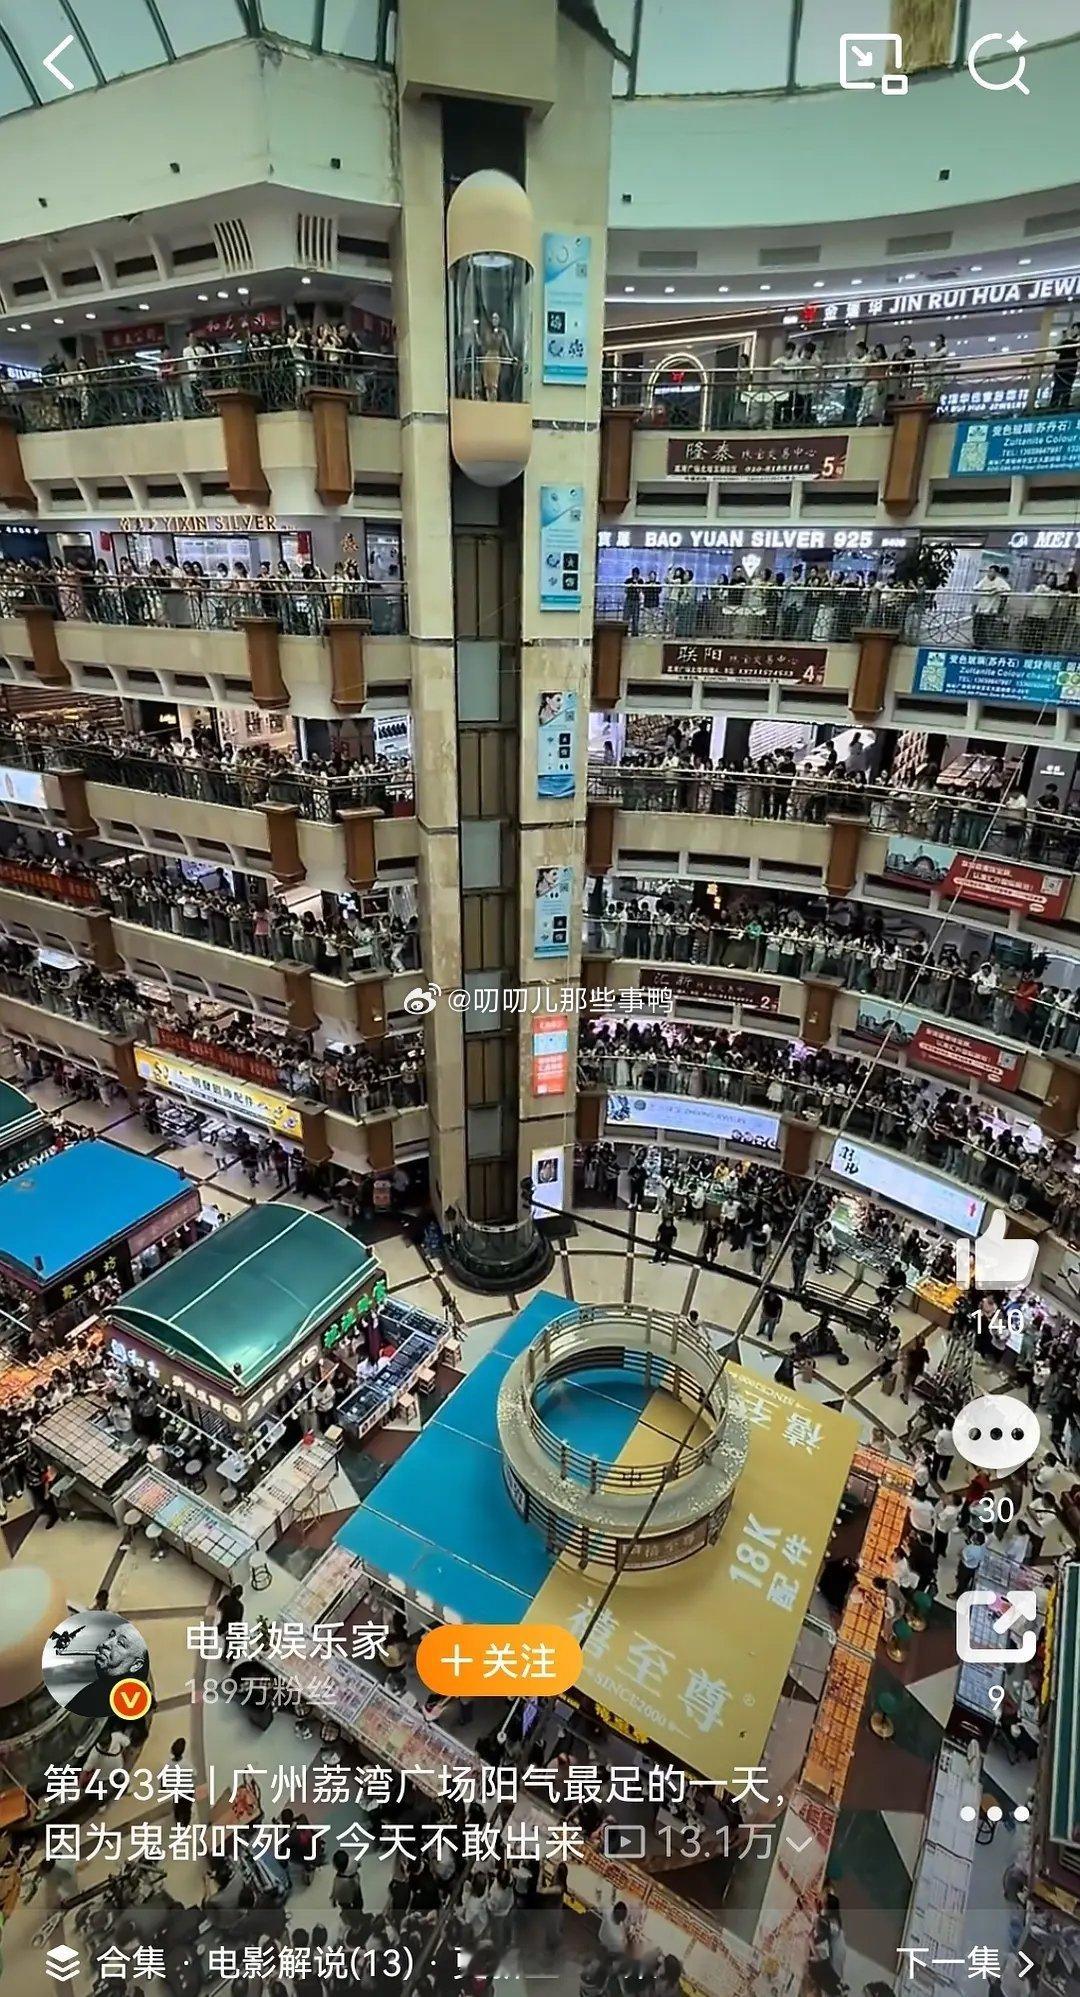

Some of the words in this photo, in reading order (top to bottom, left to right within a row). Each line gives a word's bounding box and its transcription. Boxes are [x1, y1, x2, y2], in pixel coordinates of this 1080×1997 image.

[889, 294, 924, 314] JIN
[927, 287, 970, 311] RUI
[970, 283, 1020, 307] HUA
[1045, 434, 1076, 444] Colour
[215, 514, 277, 531] SILVER
[644, 531, 680, 547] BAO
[690, 530, 744, 547] YUAN
[751, 530, 826, 548] SILVER
[833, 530, 873, 548] 925
[997, 668, 1025, 678] Colour
[728, 1513, 783, 1591] 18K
[766, 1533, 814, 1612] 配件
